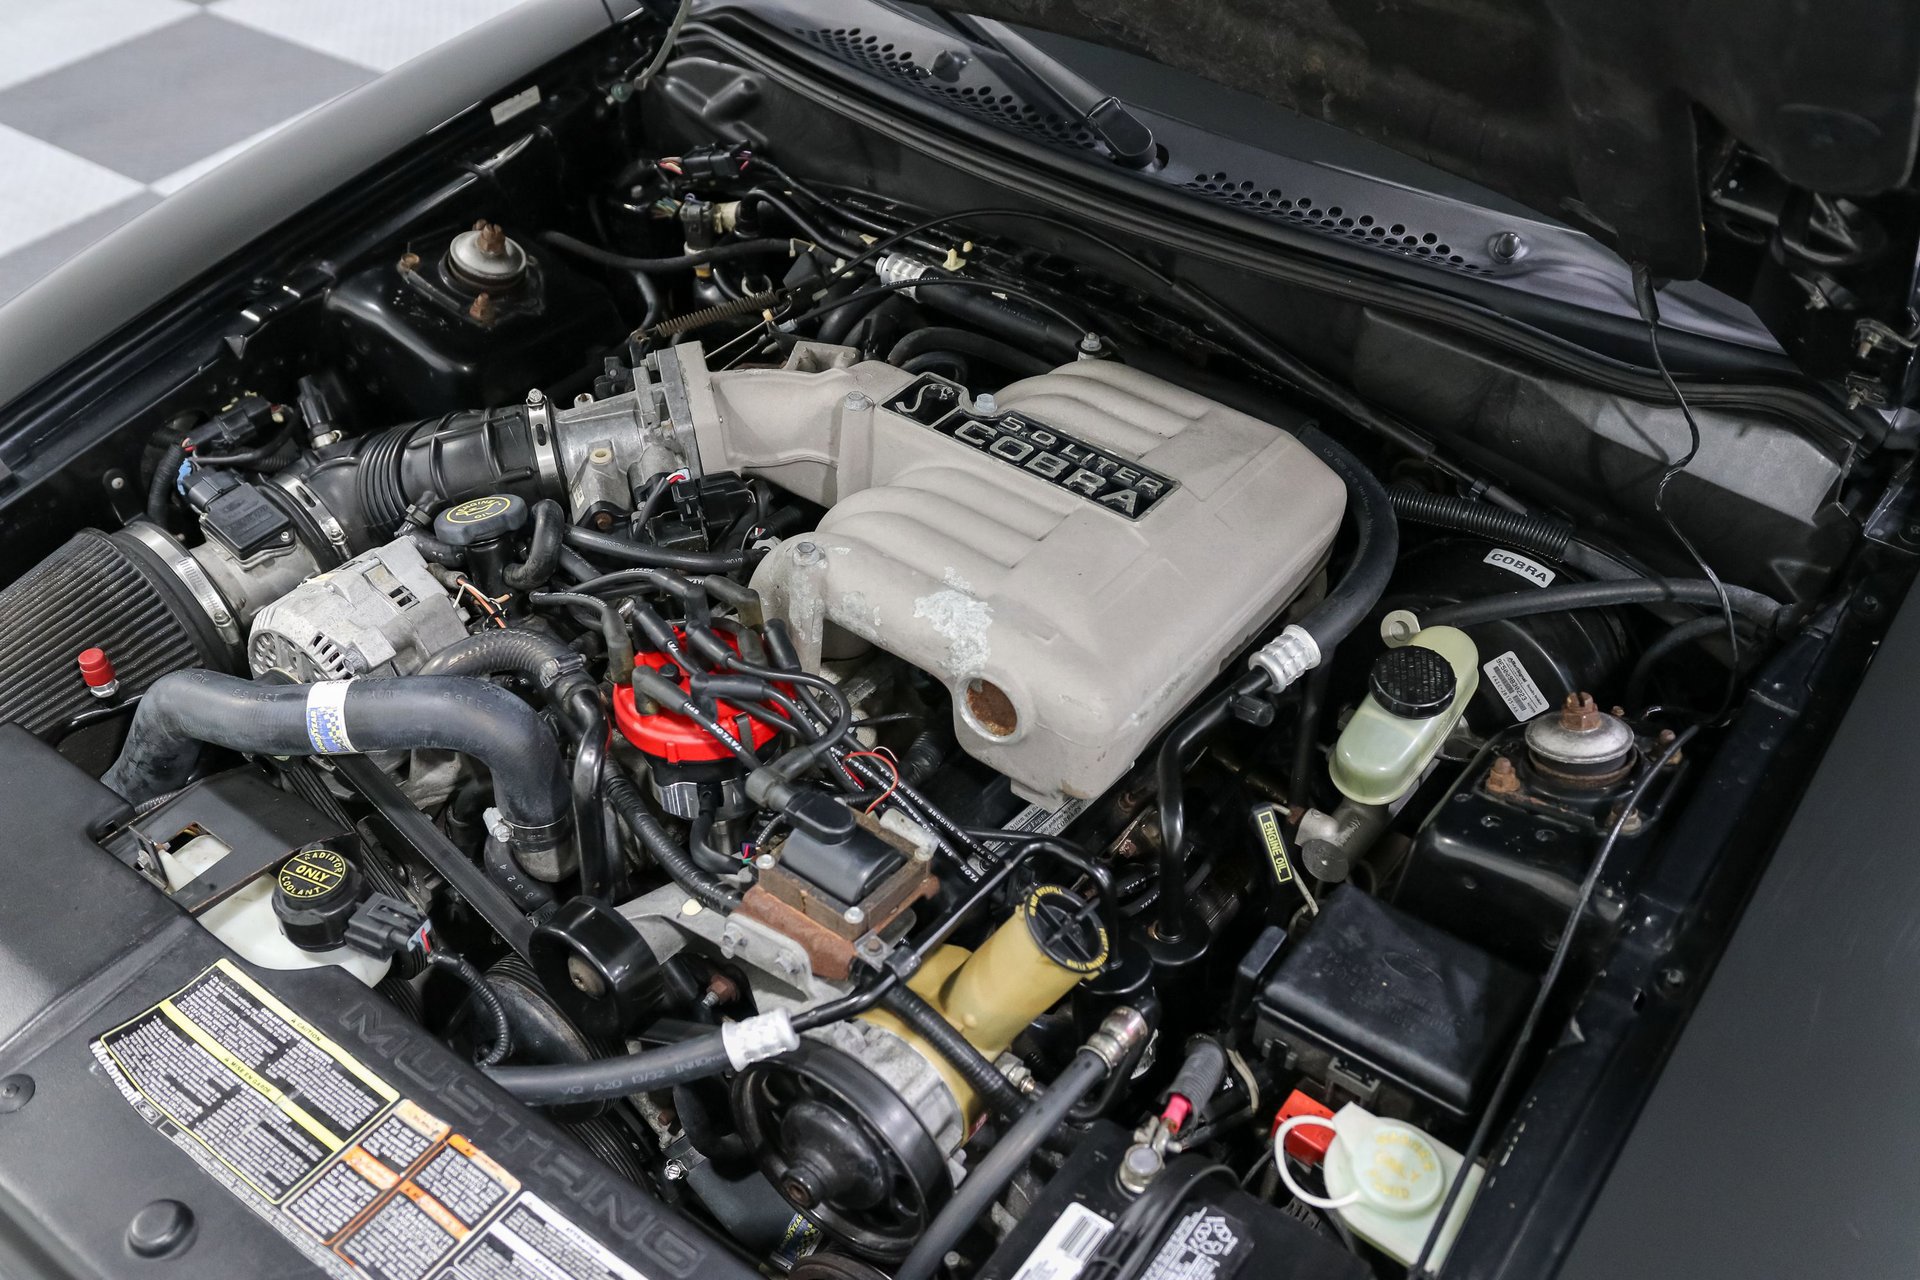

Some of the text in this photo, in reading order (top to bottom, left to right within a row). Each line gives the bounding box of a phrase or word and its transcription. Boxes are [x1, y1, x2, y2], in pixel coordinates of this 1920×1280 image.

[999, 416, 1164, 496] 5.0 LITER
[954, 420, 1138, 515] COBRA
[1490, 553, 1546, 582] COBRA
[711, 723, 743, 751] TAYLOR
[854, 761, 873, 777] MADE
[879, 781, 907, 807] SILICNE
[906, 789, 924, 805] MADE
[928, 807, 955, 832] SILICONE
[939, 840, 953, 856] SPIR
[1263, 821, 1287, 873] ENGINE OIL
[304, 852, 343, 873] RADIATOR
[960, 864, 979, 882] YLOR
[295, 865, 331, 882] ONLY
[281, 876, 321, 896] COOLANT
[296, 1022, 321, 1041] CAUTION
[89, 1042, 141, 1105] Motorcraft
[229, 1061, 244, 1072] MISE
